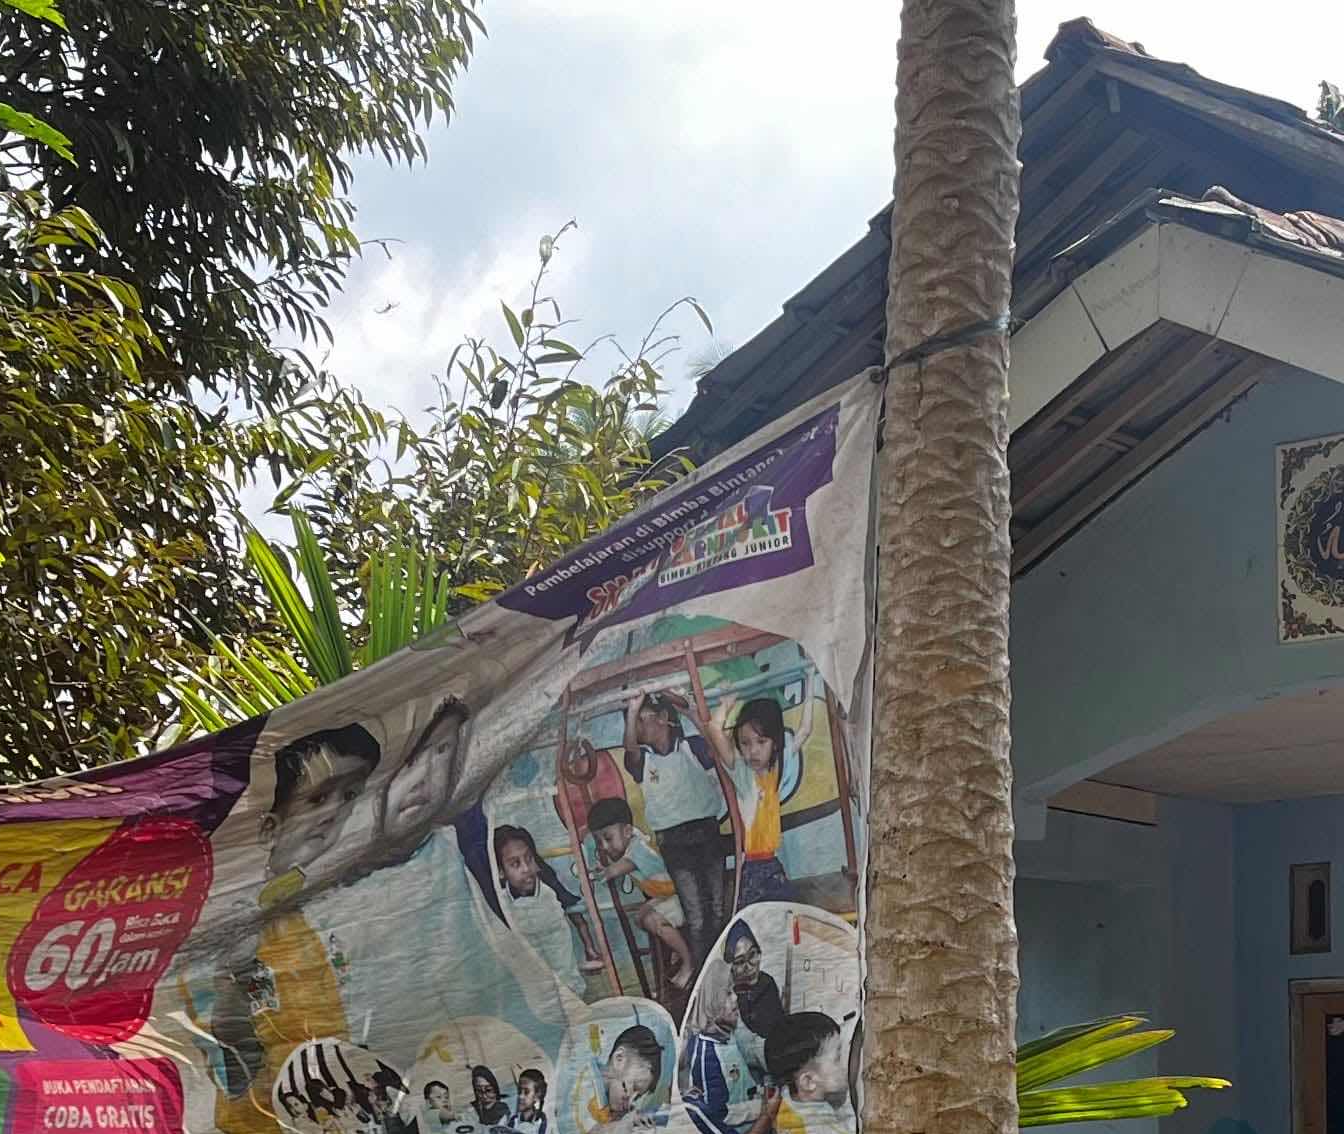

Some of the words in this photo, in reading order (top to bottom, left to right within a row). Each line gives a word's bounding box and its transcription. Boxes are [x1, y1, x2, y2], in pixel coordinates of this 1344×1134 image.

[524, 533, 636, 598] Pembelajaran
[635, 522, 655, 539] di
[651, 494, 707, 529] Bimba
[744, 535, 790, 555] JUNIOR
[63, 866, 193, 912] GARANSI
[24, 917, 117, 992] 60
[43, 1105, 93, 1129] COBA
[95, 1104, 155, 1129] GRATIS
